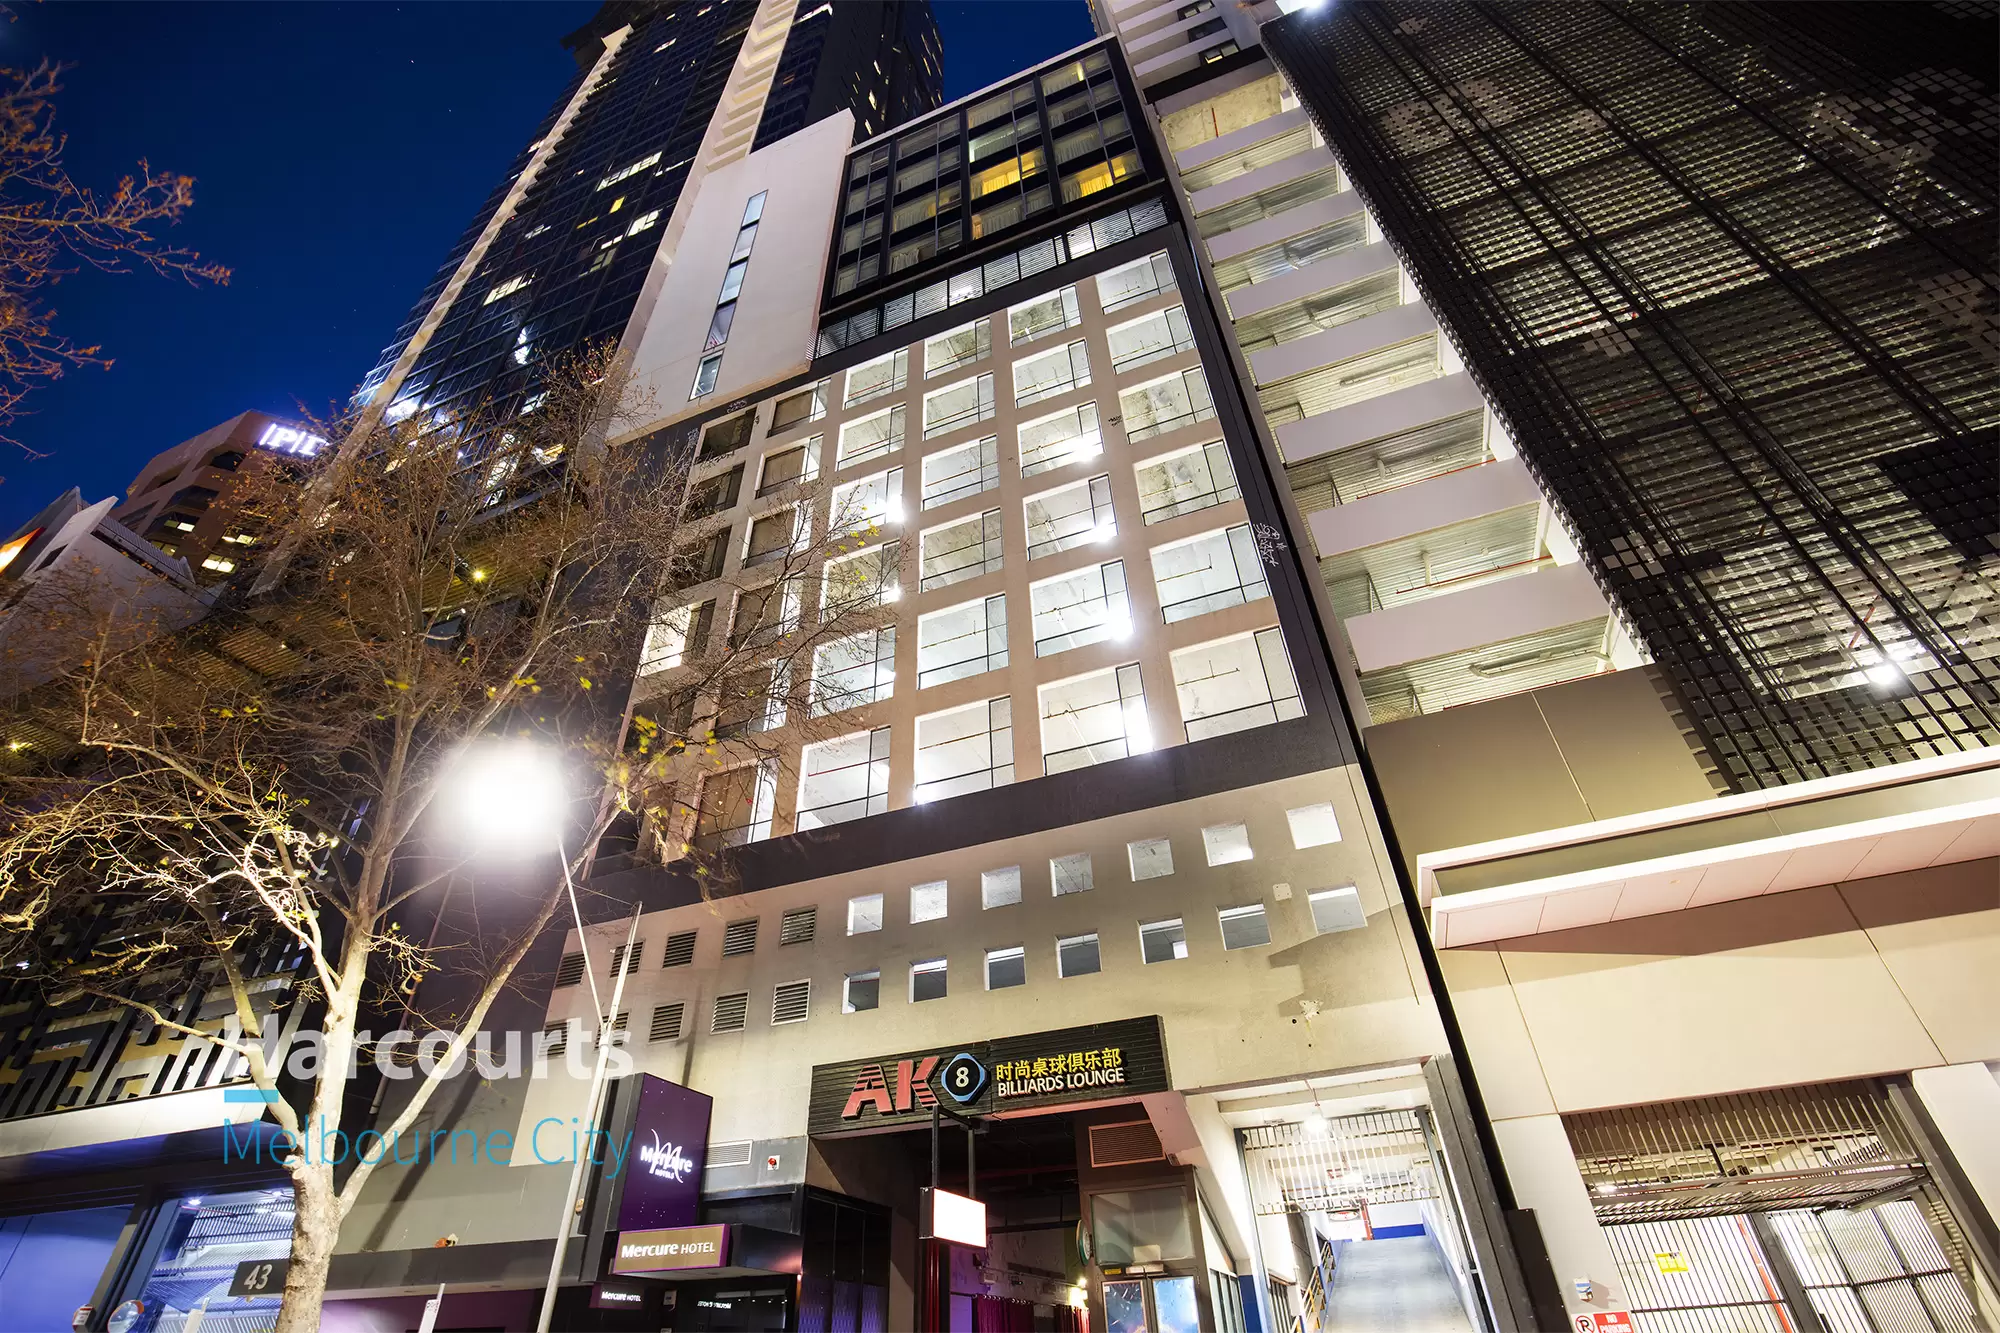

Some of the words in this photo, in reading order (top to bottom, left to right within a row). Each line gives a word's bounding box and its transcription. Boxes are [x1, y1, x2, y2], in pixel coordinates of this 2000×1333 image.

[996, 1047, 1122, 1081] 时尚桌球俱乐部
[841, 1056, 941, 1121] AK
[955, 1066, 971, 1089] 8
[998, 1074, 1065, 1097] BILLIARDS
[1066, 1067, 1126, 1089] LOUNGE
[621, 1243, 680, 1259] Mercure
[680, 1242, 716, 1255] HOTEL
[243, 1263, 273, 1290] 43
[601, 1291, 627, 1301] Mercure
[627, 1294, 642, 1302] HOTEL
[1599, 1323, 1632, 1333] PARKING
[1605, 1313, 1618, 1324] NO
